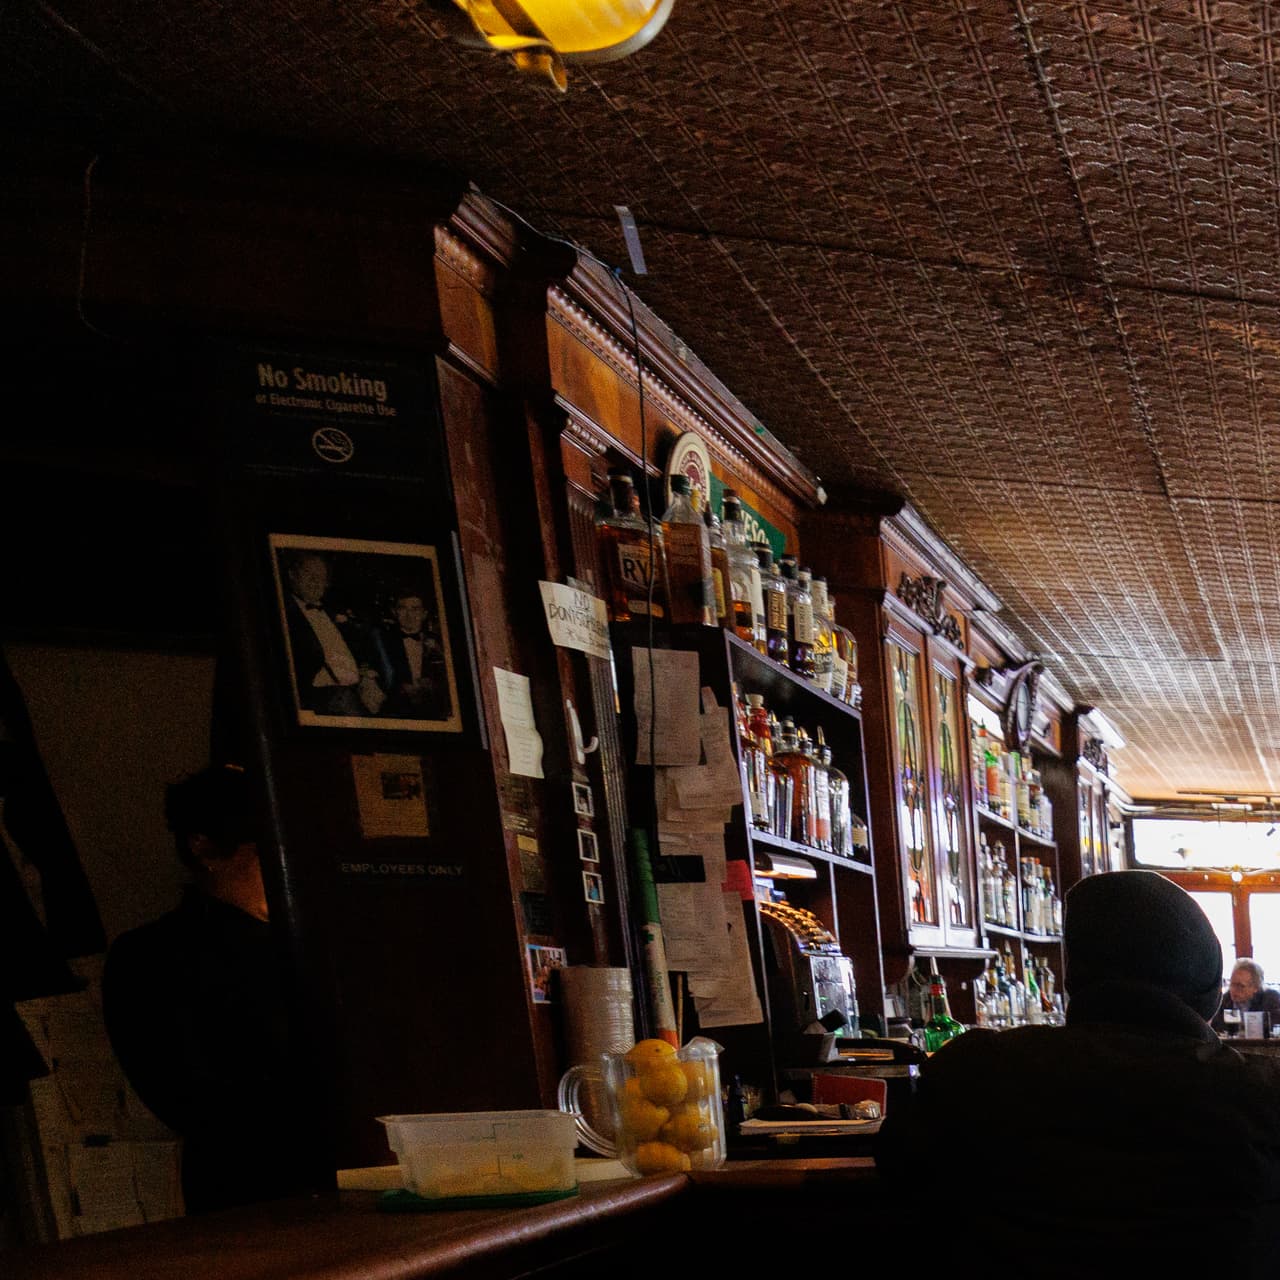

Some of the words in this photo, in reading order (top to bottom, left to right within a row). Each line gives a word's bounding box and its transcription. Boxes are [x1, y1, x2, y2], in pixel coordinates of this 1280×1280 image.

[257, 362, 289, 389] No
[293, 367, 388, 403] Smoking
[341, 863, 424, 875] EMPLOYEES
[427, 863, 464, 876] ONLY
